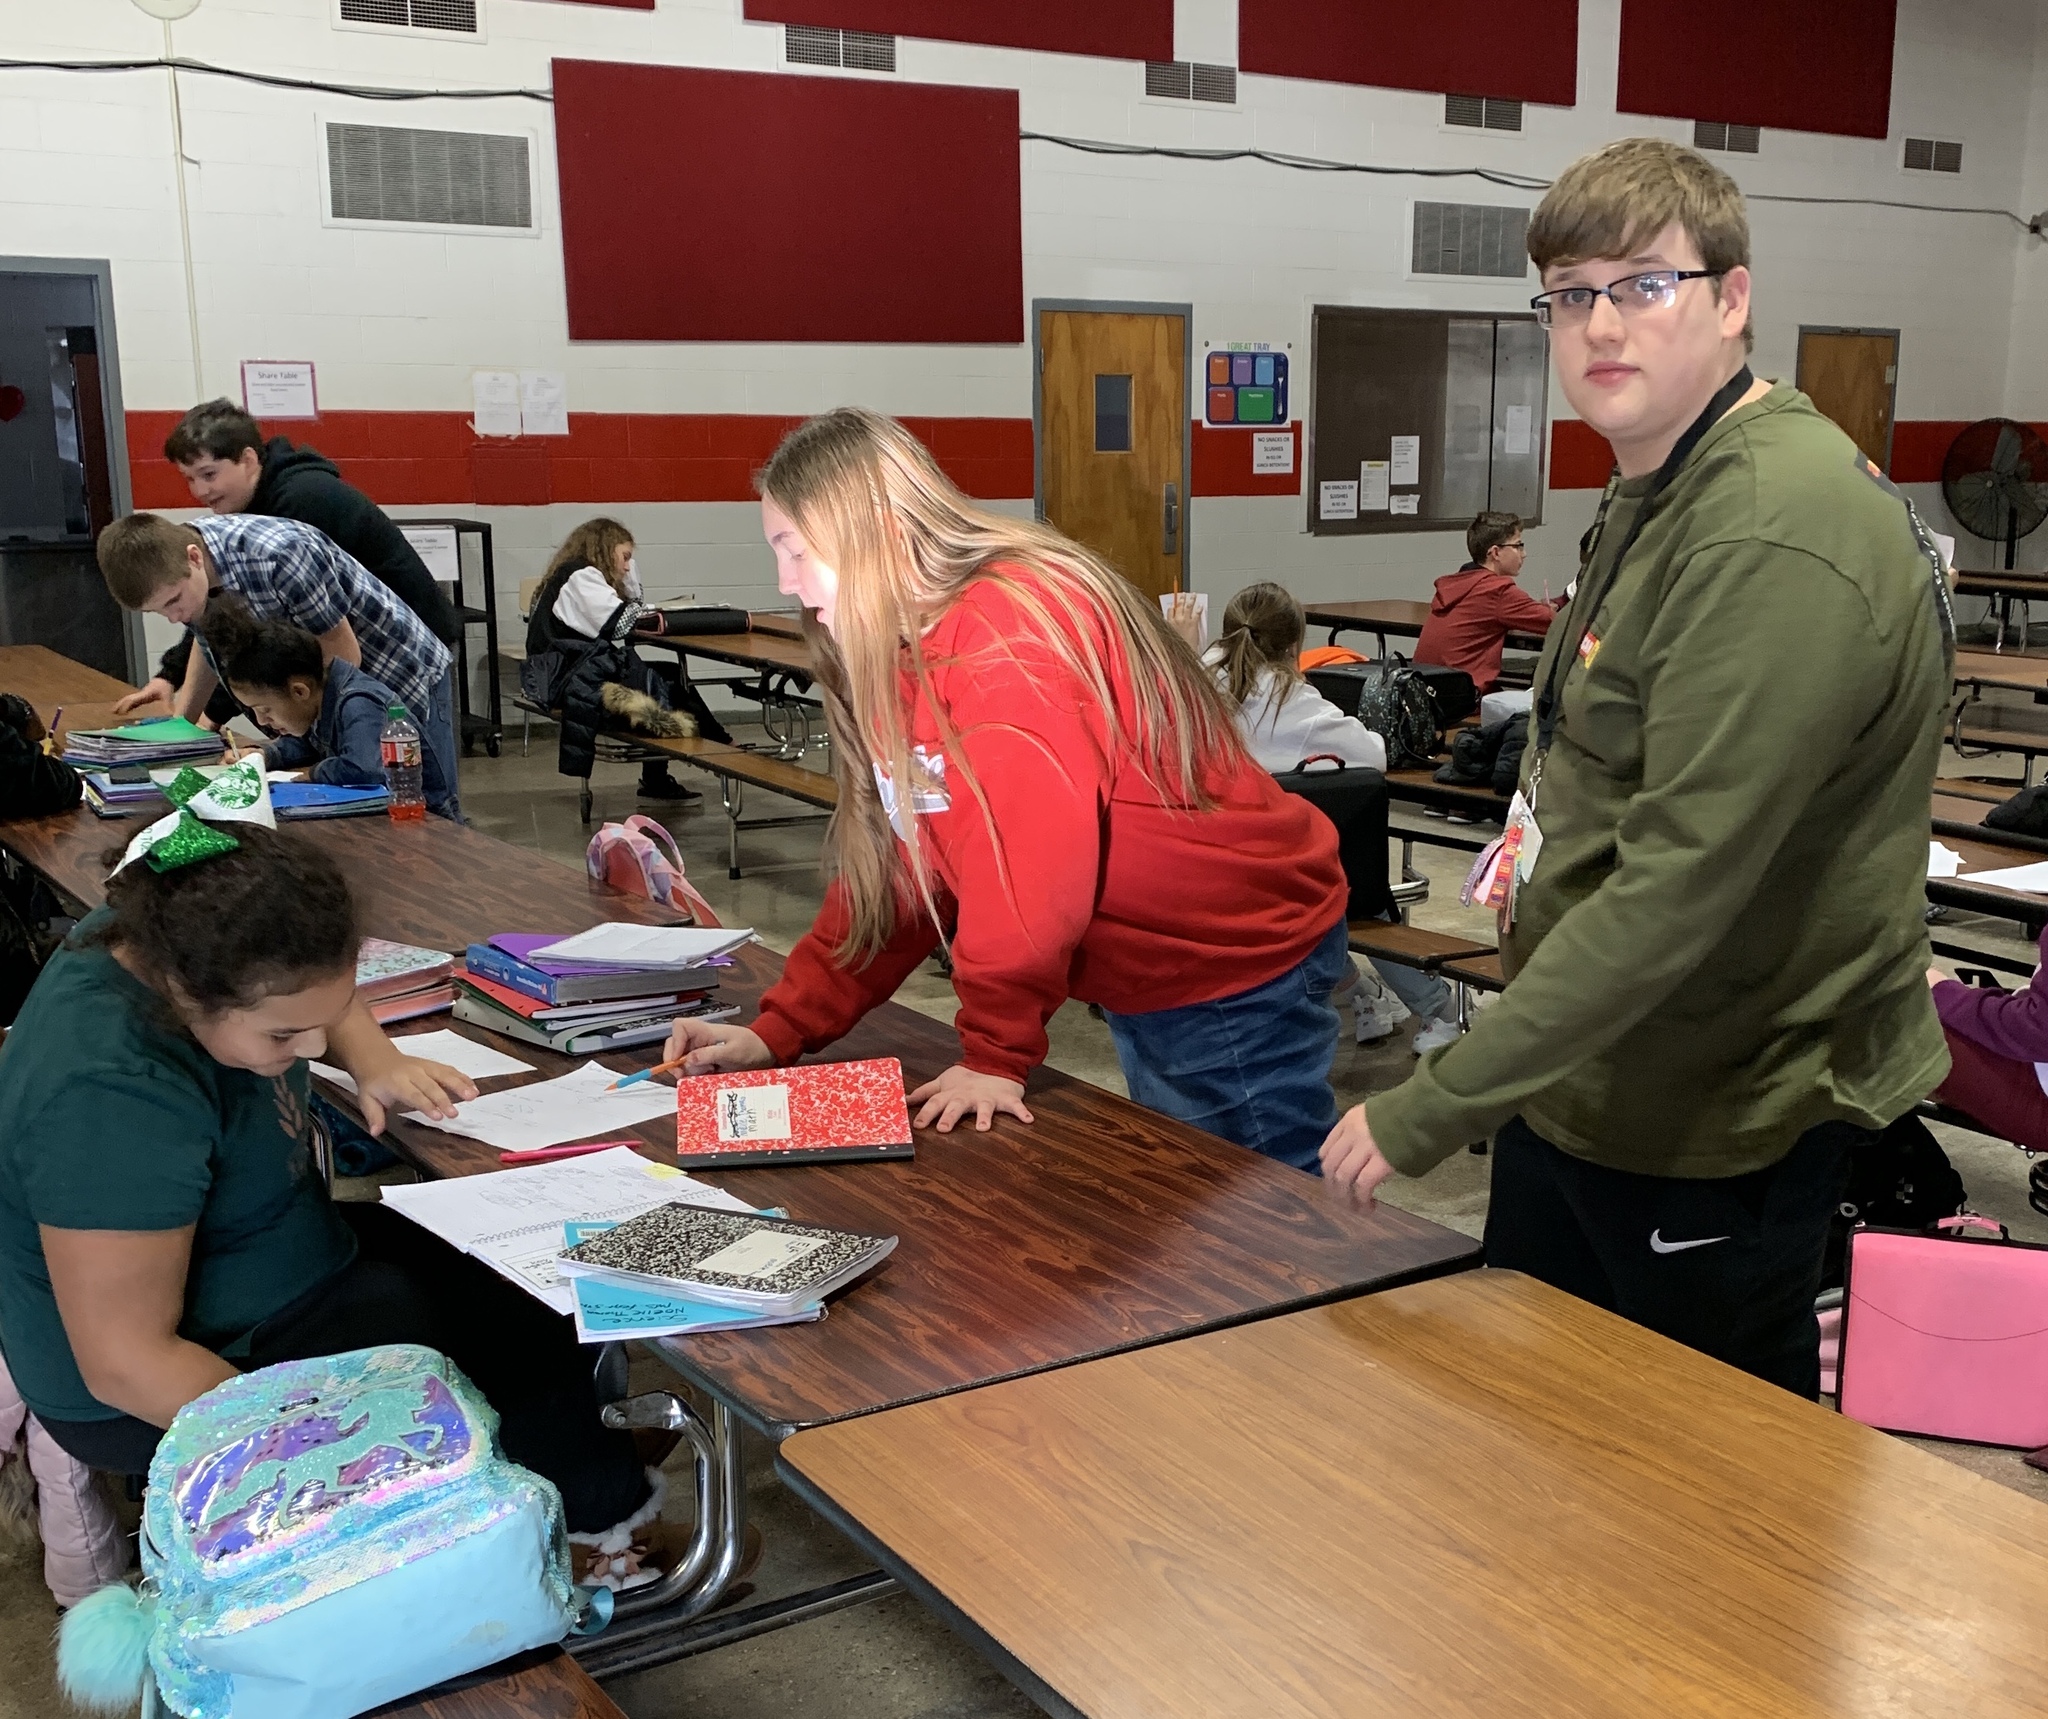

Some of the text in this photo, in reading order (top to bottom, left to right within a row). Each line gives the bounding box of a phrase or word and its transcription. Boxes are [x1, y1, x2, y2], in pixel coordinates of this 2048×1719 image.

[1231, 342, 1252, 351] GREAT
[1254, 343, 1271, 351] TRAY
[602, 1314, 688, 1323] Science
